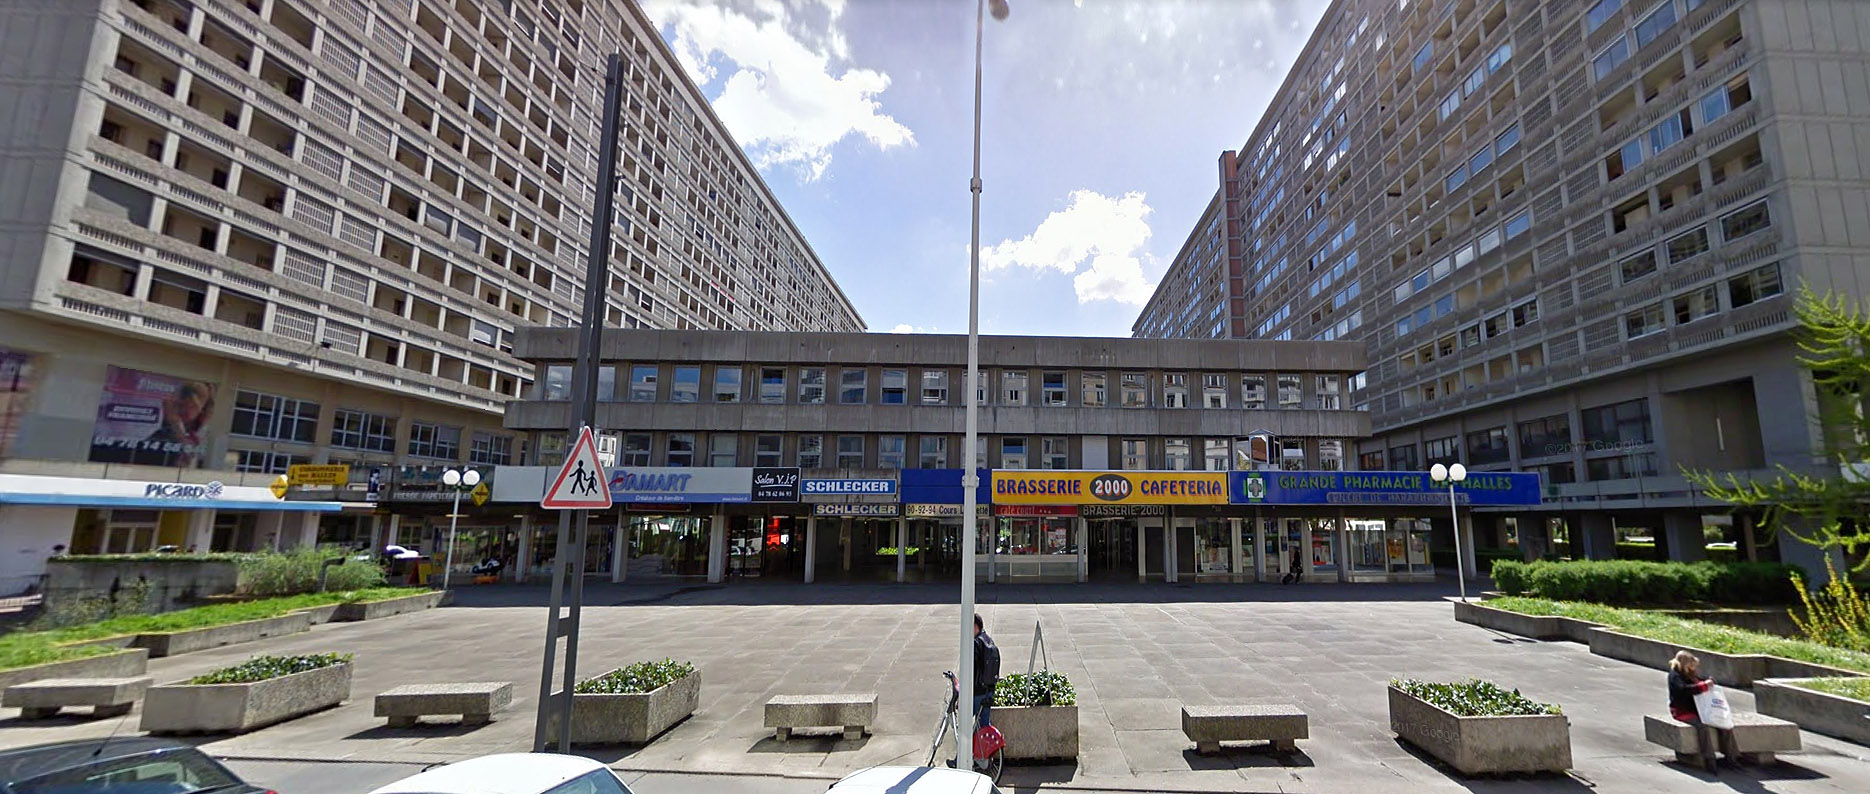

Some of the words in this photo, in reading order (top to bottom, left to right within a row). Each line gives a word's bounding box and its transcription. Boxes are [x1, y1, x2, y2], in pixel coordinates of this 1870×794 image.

[609, 470, 692, 491] DAMART
[806, 481, 889, 492] SCHLECKER
[996, 479, 1082, 495] BRASSERIE
[1094, 479, 1129, 496] 2000
[1140, 479, 1222, 496] CAFETERIA
[1279, 476, 1336, 489] GRANDE
[1343, 476, 1421, 490] PHARMACIE
[144, 484, 203, 498] PICARD
[816, 505, 897, 514] SCHLECKER
[906, 505, 936, 514] 90-92-94
[939, 505, 957, 514] Cours
[960, 504, 988, 514] Lette
